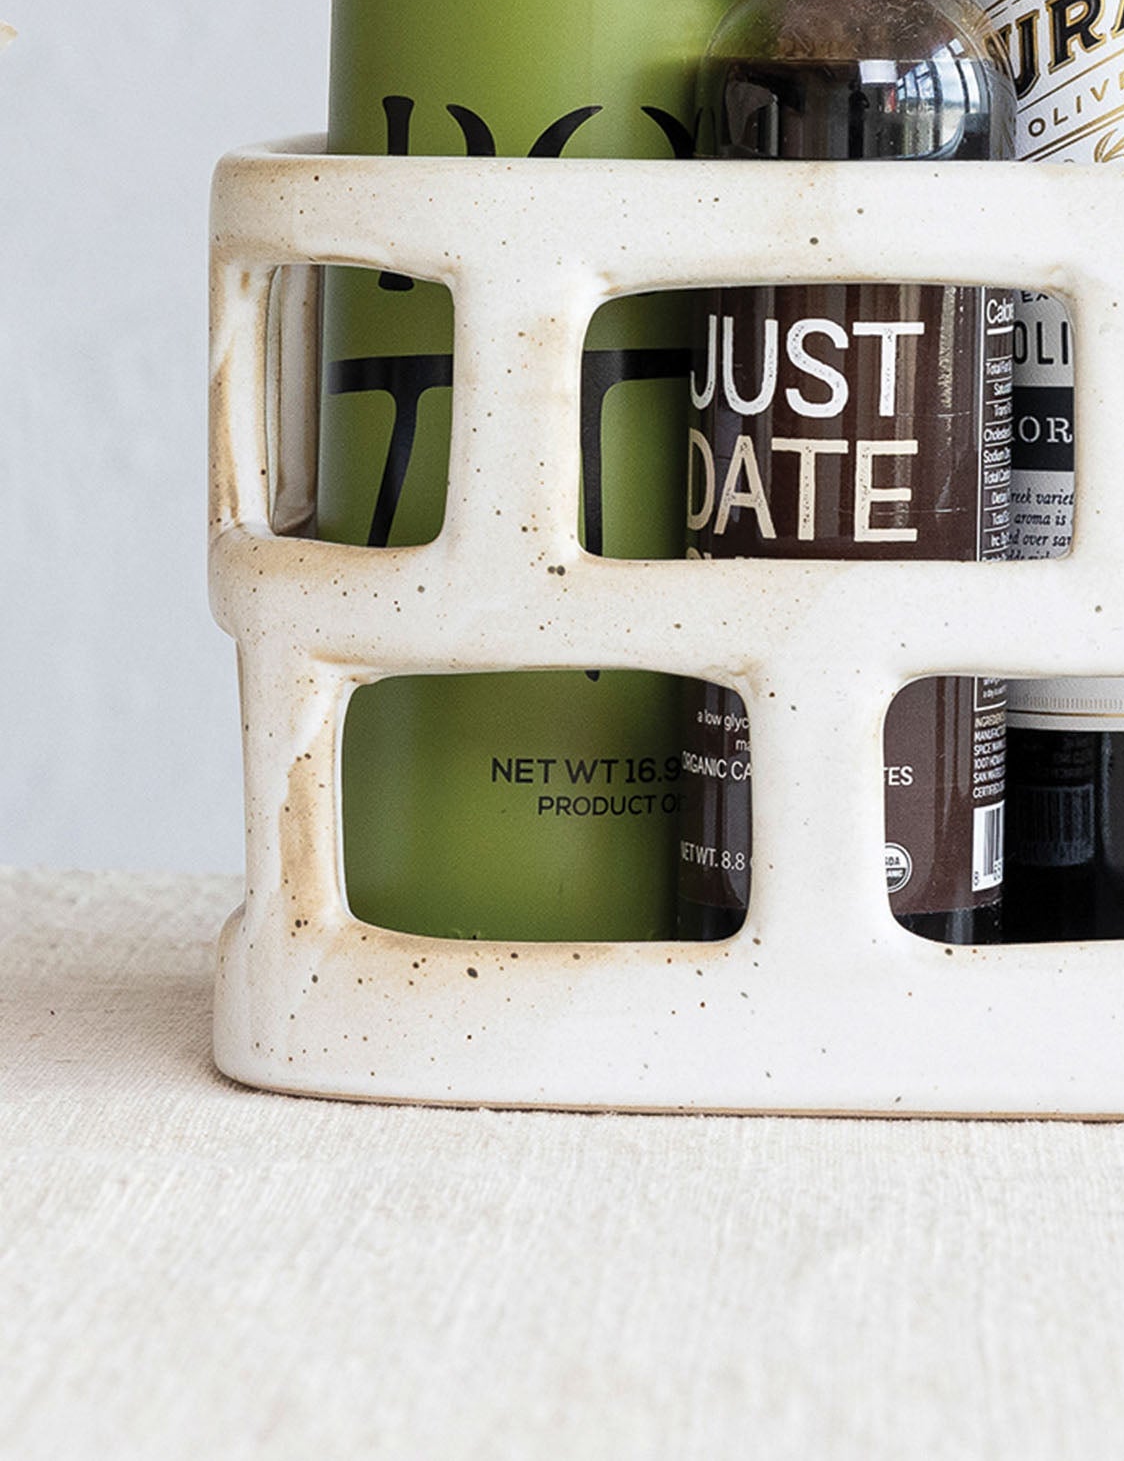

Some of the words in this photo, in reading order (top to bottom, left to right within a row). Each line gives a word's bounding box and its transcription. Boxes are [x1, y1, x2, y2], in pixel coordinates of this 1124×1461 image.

[690, 315, 925, 419] JUST
[1015, 416, 1073, 444] OR
[686, 427, 919, 543] DATE
[491, 757, 557, 784] NET
[565, 758, 619, 784] WT
[625, 756, 681, 784] 16.9
[538, 795, 657, 816] PRODUCT
[721, 850, 746, 871] 8.8
